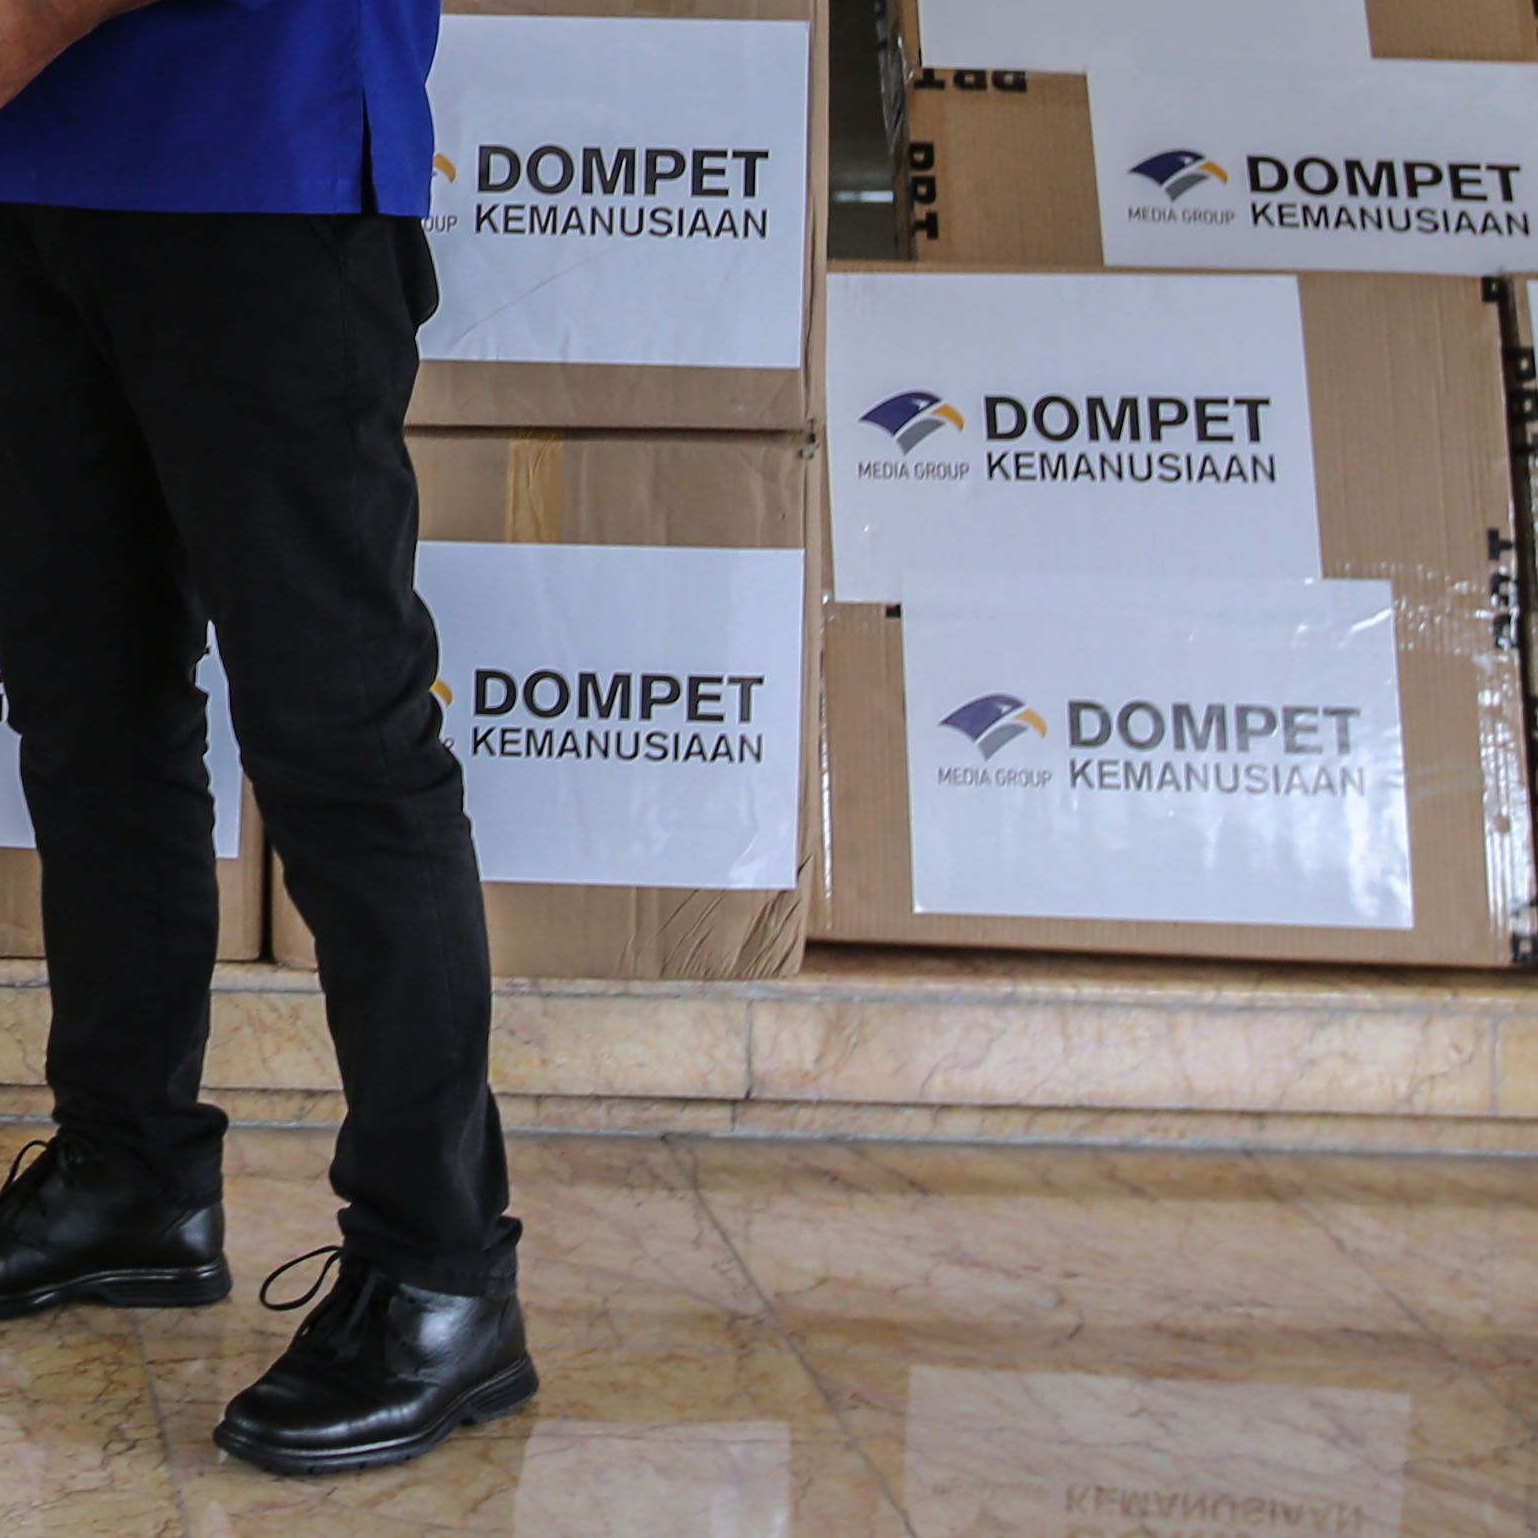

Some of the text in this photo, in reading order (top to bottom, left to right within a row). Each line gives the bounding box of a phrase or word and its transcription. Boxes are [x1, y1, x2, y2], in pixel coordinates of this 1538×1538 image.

[478, 145, 769, 198] DOMPET
[1247, 156, 1520, 202] DOMPET
[426, 215, 457, 232] OUP
[476, 204, 766, 238] KEMANUSIAAN
[1128, 207, 1235, 224] MEDIA GROUP
[1251, 202, 1529, 236] KEMANUSIAAN
[985, 396, 1270, 442] DOMPET
[858, 462, 969, 480] MEDIA GROUP
[987, 452, 1275, 482] KEMANUSIAAN
[474, 669, 764, 723] DOMPET
[473, 727, 762, 763] KEMANUSIAAN
[1068, 700, 1360, 755] DOMPET
[938, 766, 1052, 788] MEDIA GROUP
[1069, 758, 1364, 798] KEMANUSIAAN
